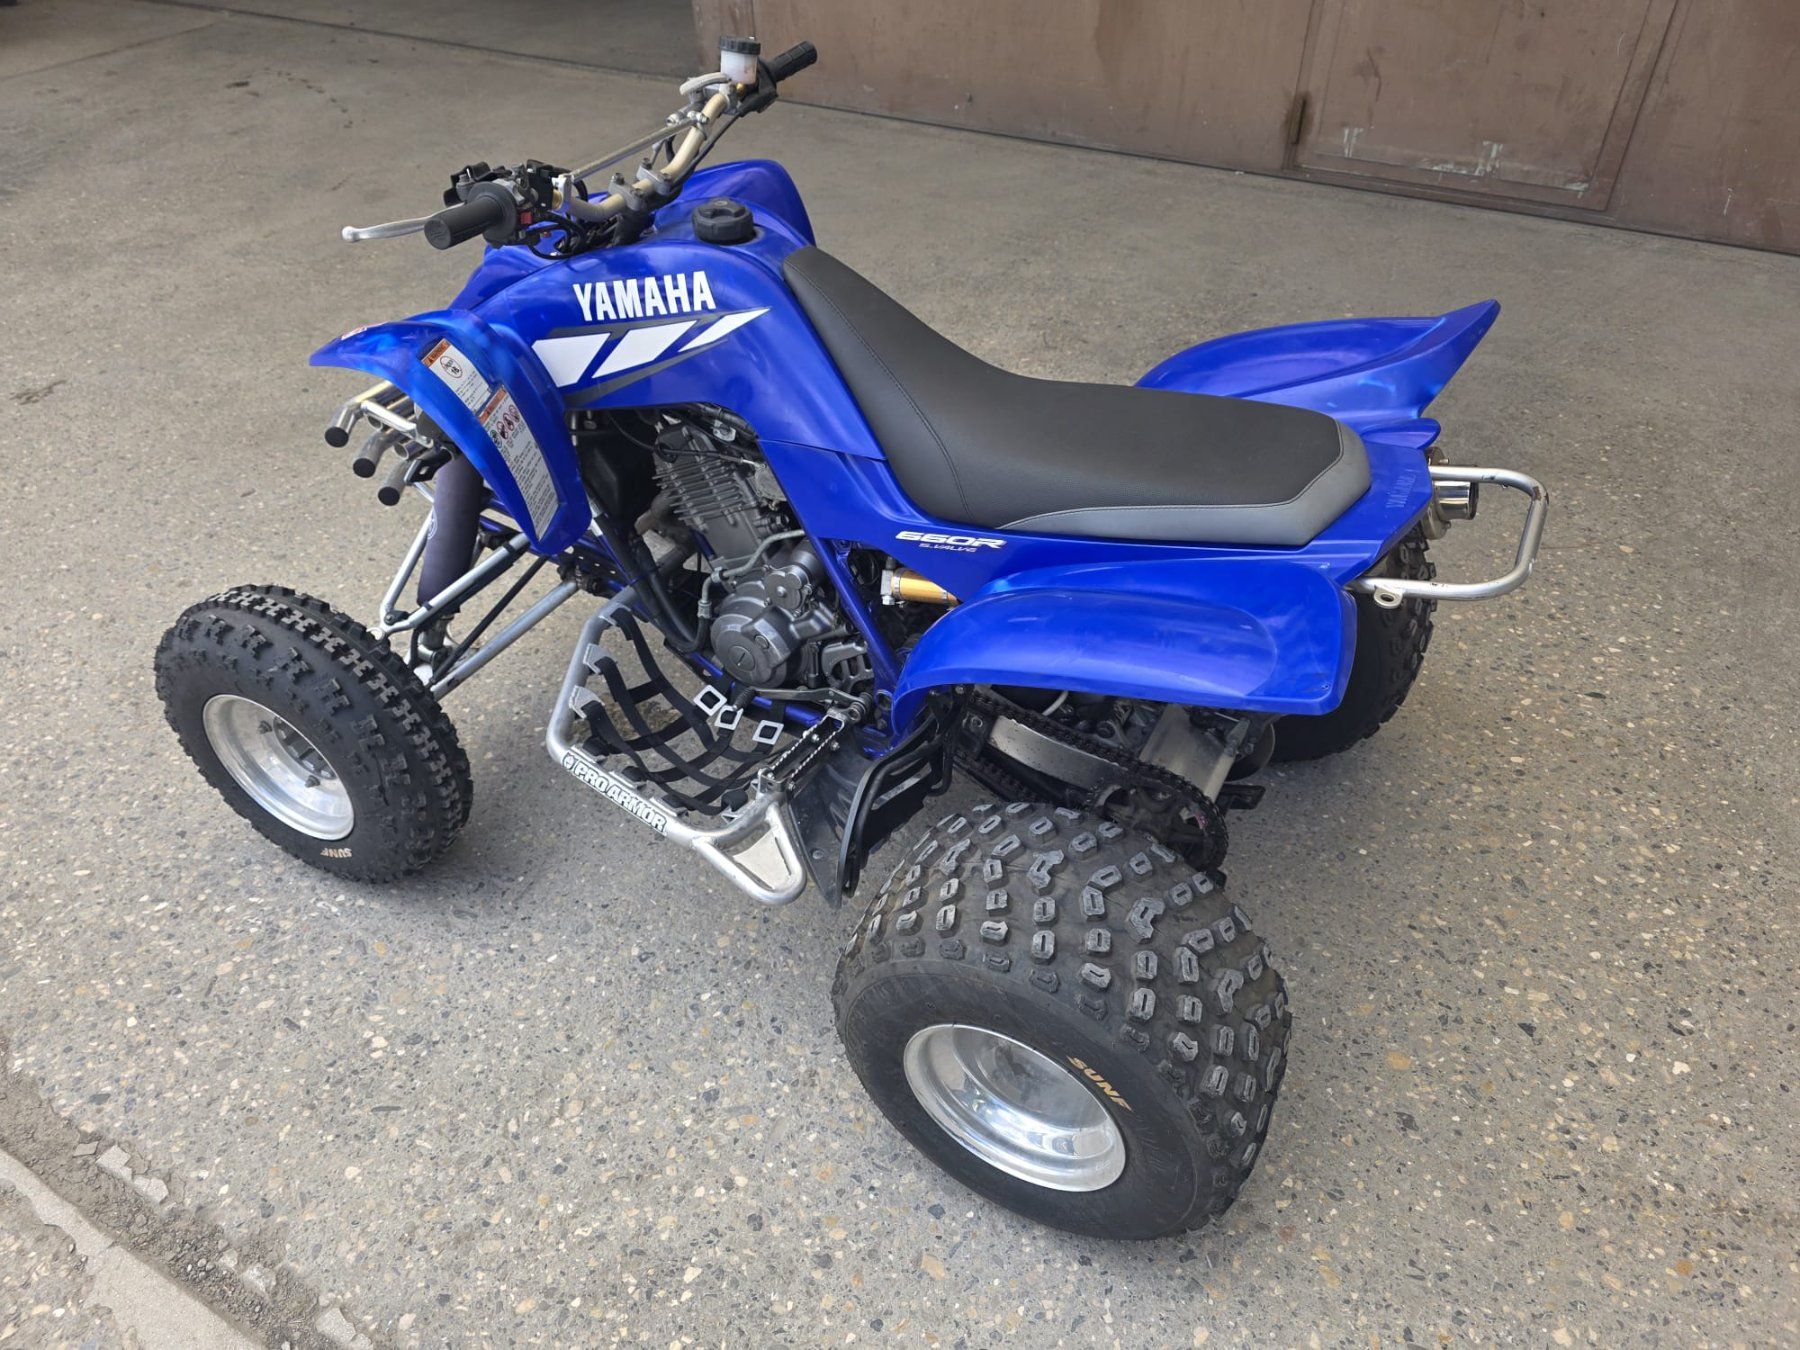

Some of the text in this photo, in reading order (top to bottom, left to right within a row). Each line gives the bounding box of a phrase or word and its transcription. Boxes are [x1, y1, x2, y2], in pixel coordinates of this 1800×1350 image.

[573, 270, 716, 322] YAMAHA
[895, 530, 1007, 549] 660R
[574, 761, 667, 833] PRO ARMOR
[320, 847, 353, 858] SUNF
[1066, 1055, 1133, 1112] SUNF
